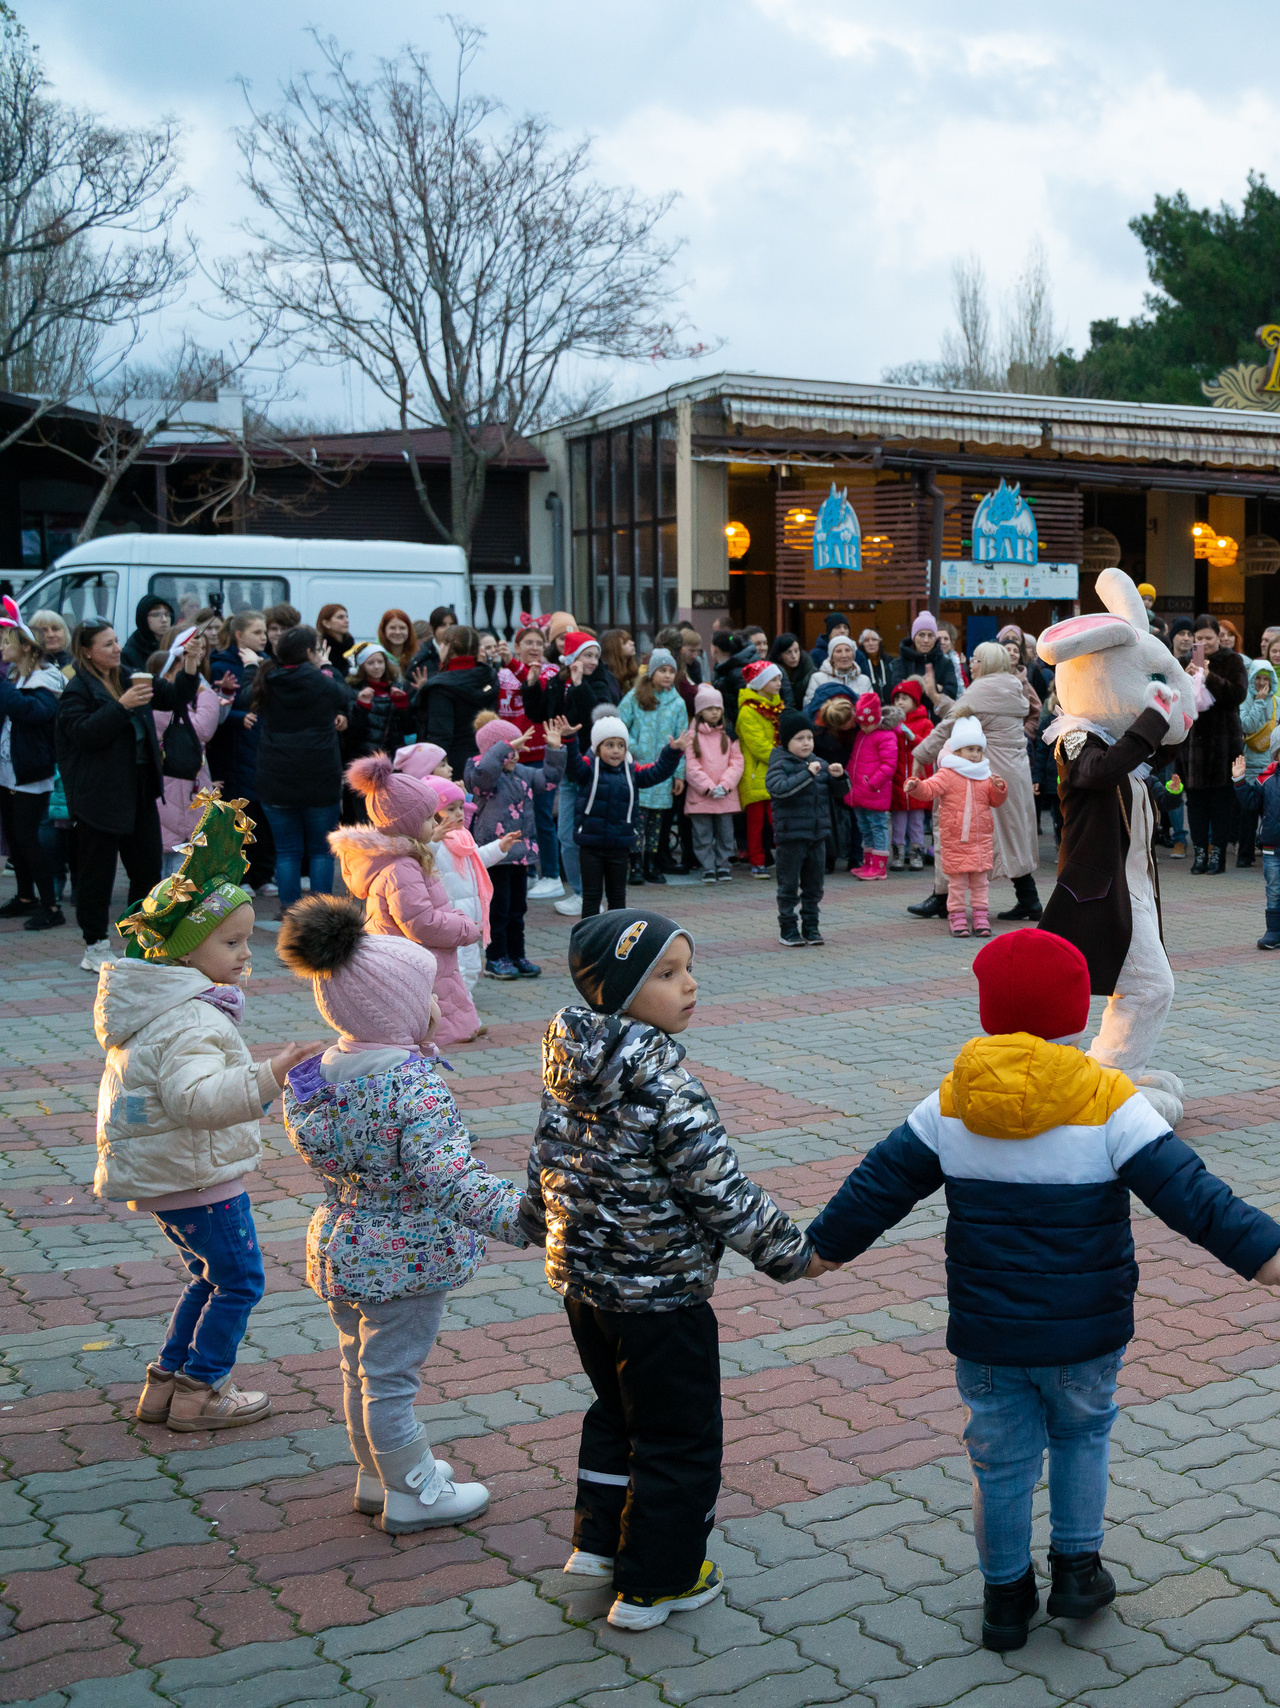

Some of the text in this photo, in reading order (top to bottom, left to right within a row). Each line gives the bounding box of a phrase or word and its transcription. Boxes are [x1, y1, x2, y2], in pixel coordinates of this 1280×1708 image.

[817, 543, 857, 567] BAR
[979, 536, 1034, 563] BAR
[391, 1237, 406, 1251] 69
